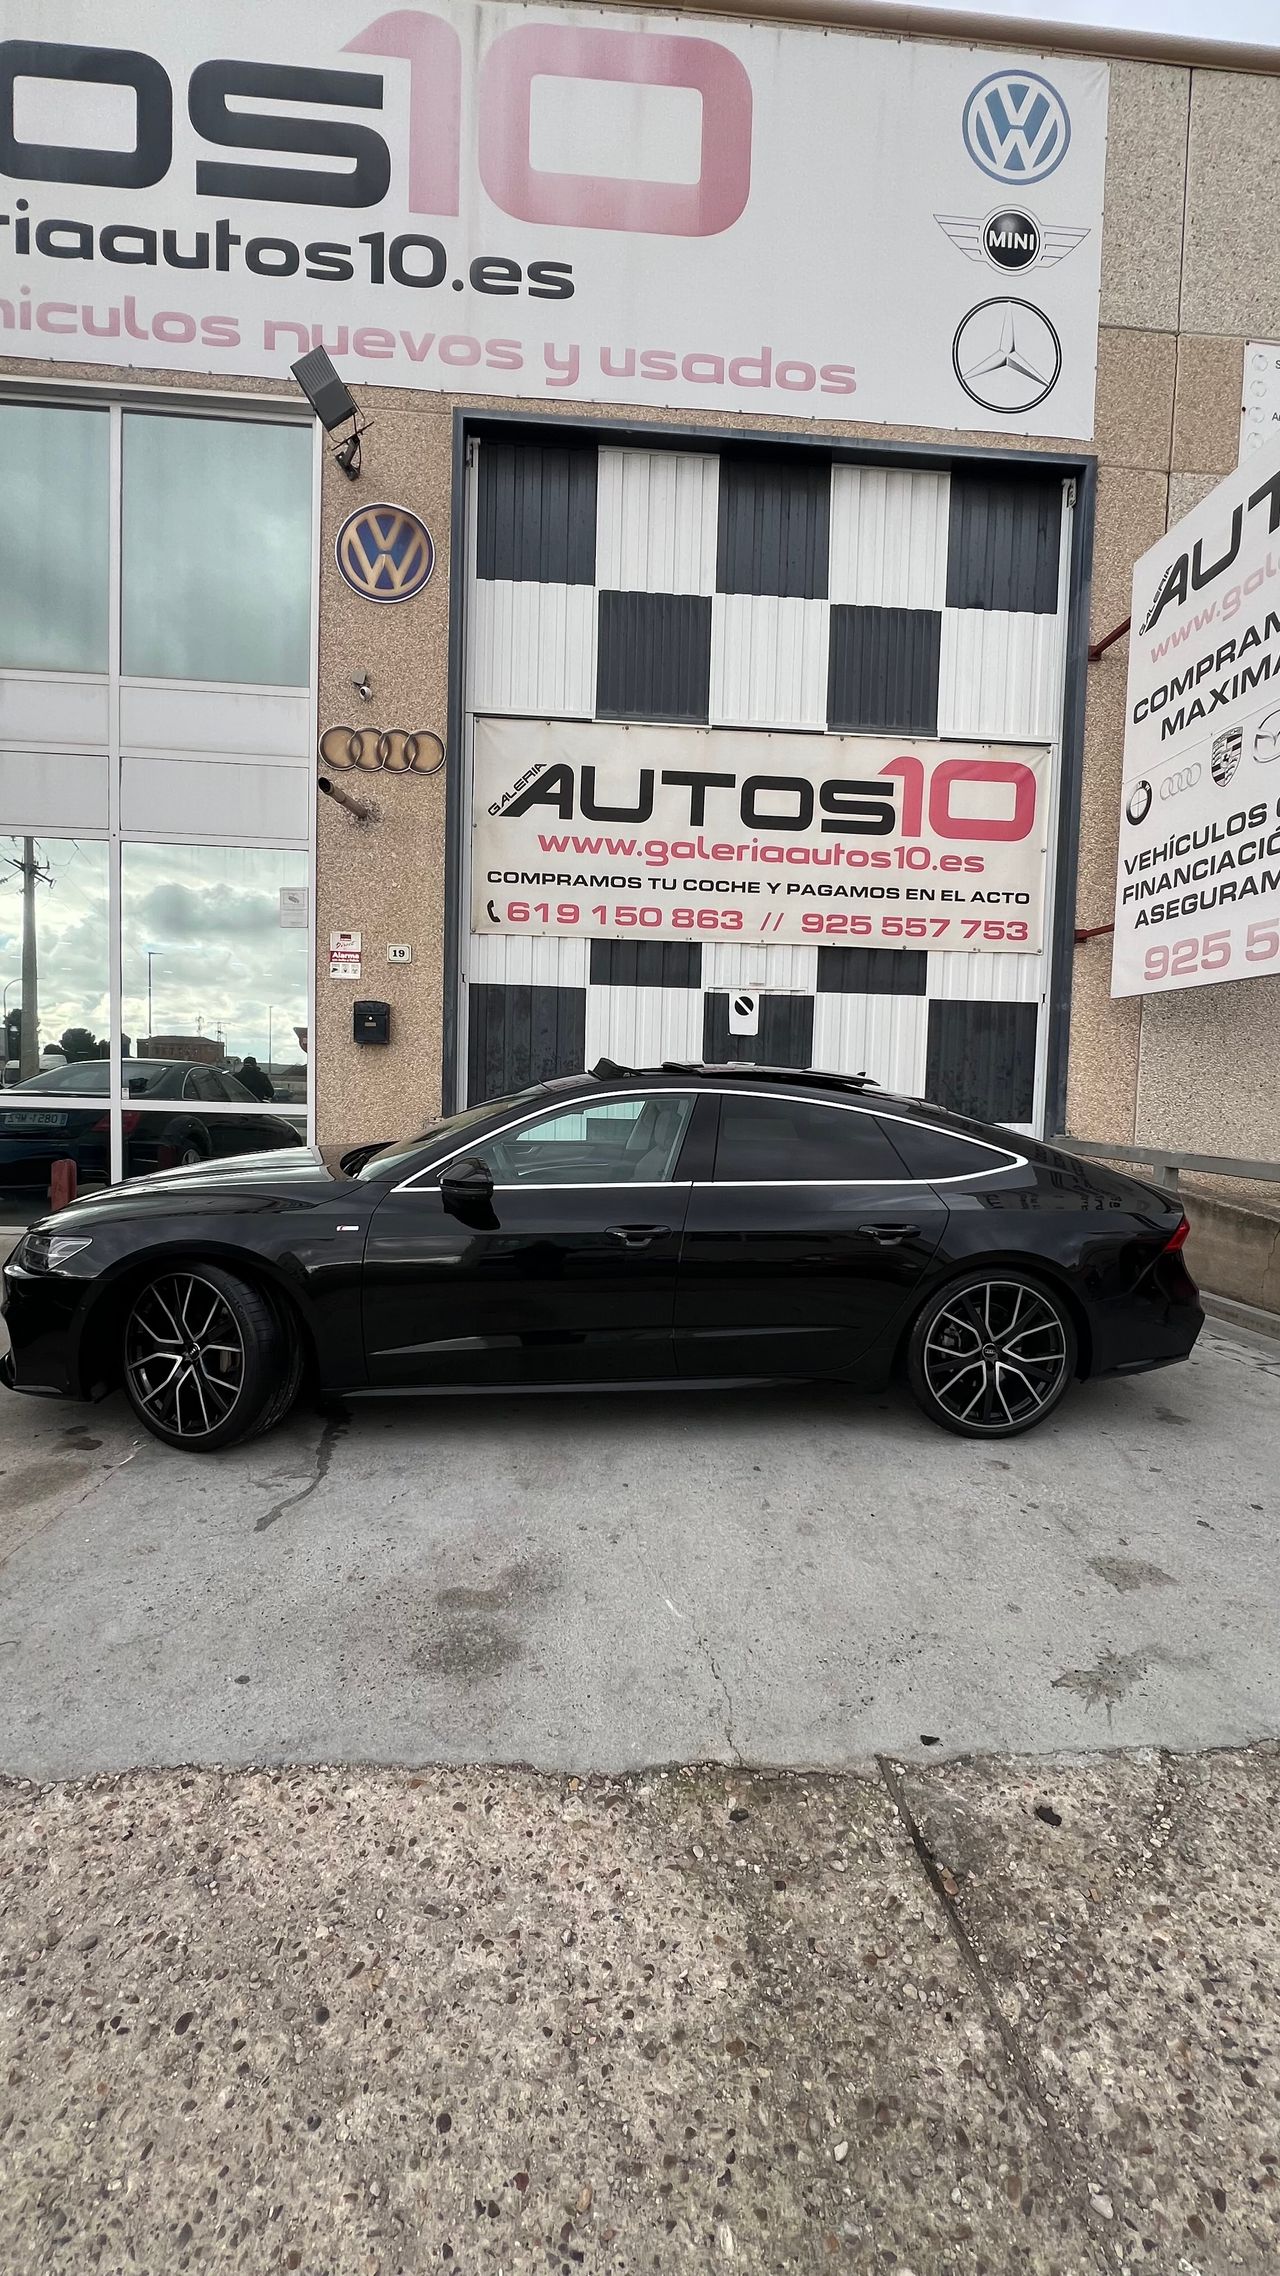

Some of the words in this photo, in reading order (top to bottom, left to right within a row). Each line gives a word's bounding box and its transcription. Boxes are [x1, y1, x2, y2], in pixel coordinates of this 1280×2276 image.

[989, 230, 1035, 250] MINI
[263, 319, 525, 371] nuevos
[543, 342, 580, 387] y
[600, 345, 857, 395] usados
[1151, 551, 1280, 664] www.gal
[487, 762, 548, 817] GALERIA
[498, 756, 1037, 842] AUTOS10
[537, 835, 985, 873] www.galeriaautos10.es
[1124, 802, 1267, 876] VEHÍCULOS
[487, 870, 642, 889] COMPRAMOS
[647, 877, 677, 891] TU
[683, 879, 760, 894] COCHE
[767, 882, 781, 895] Y
[787, 883, 900, 900] PAGAMOS
[905, 888, 935, 901] EN
[941, 890, 965, 902] EL
[970, 891, 1030, 905] ACTO
[507, 901, 580, 924] 619
[591, 905, 663, 927] 150
[671, 908, 744, 931] 863
[801, 913, 873, 935] 925
[881, 916, 950, 938] 557
[960, 919, 1029, 941] 753
[332, 951, 360, 959] Alarma
[392, 949, 405, 958] 19
[1144, 929, 1232, 981] 925
